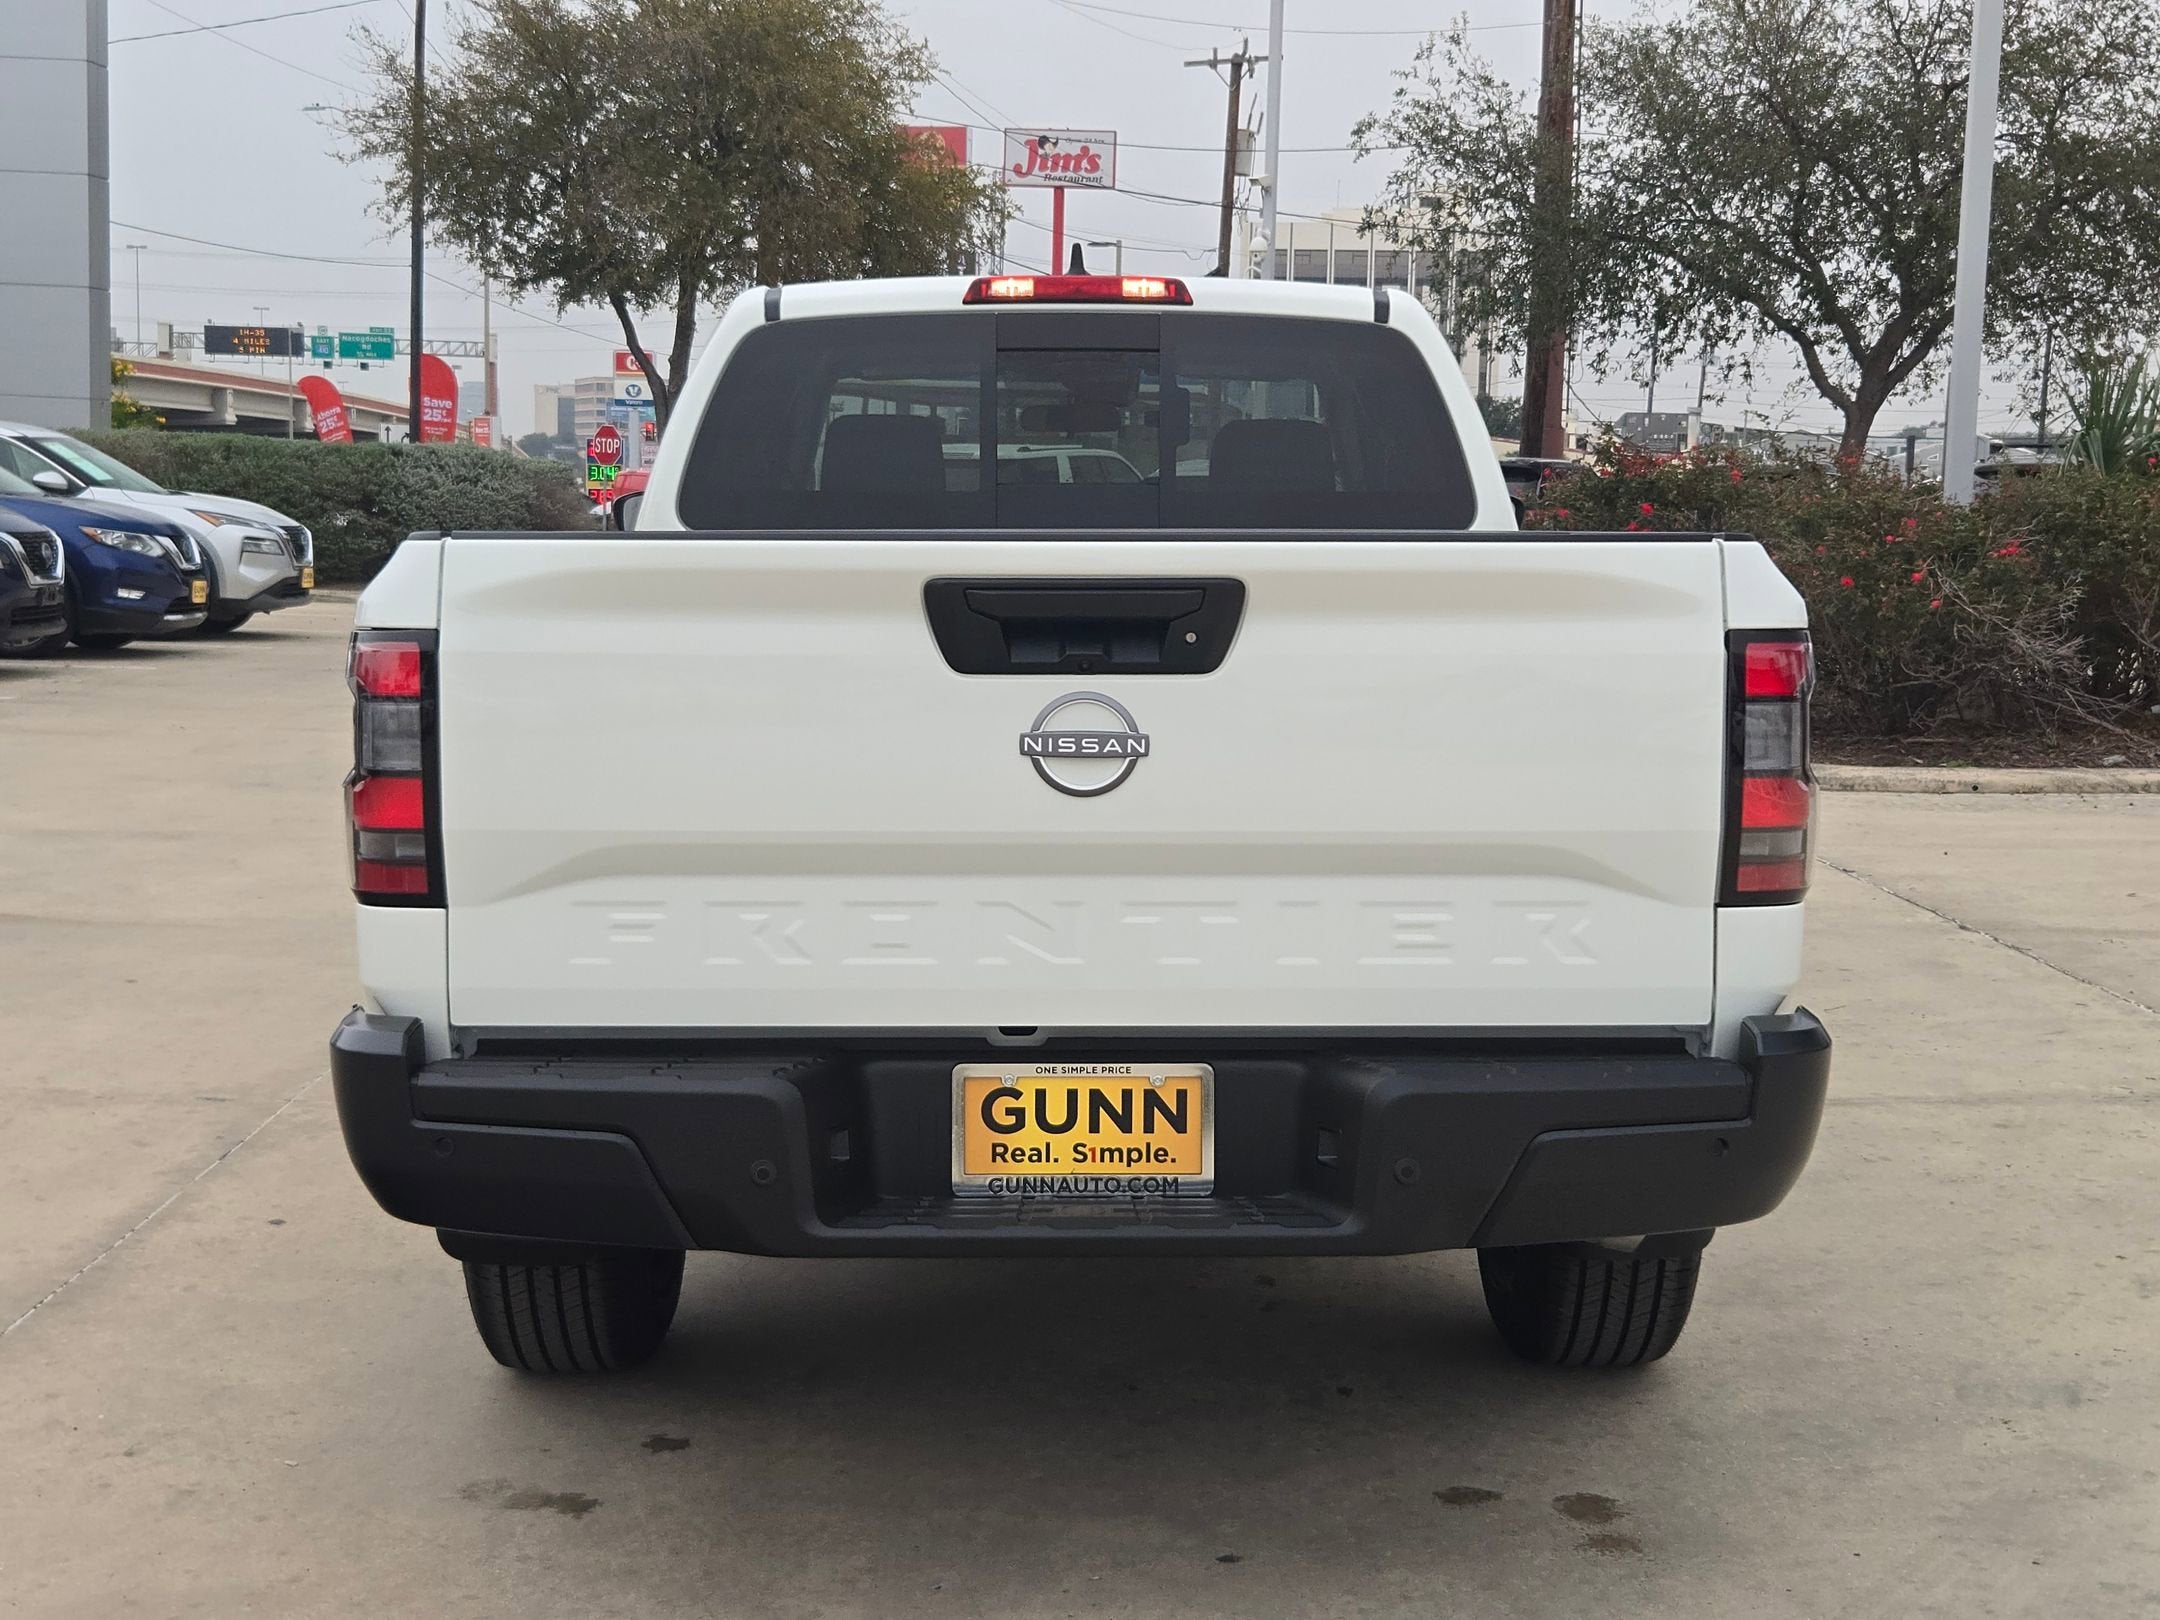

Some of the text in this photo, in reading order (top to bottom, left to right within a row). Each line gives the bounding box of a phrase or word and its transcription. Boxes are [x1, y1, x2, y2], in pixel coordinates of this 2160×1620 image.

[1013, 138, 1102, 178] Jim's
[1043, 173, 1103, 183] Restaurant
[342, 335, 391, 344] Nacogdoches
[423, 397, 453, 409] Save
[595, 438, 620, 454] STOP
[1024, 737, 1146, 754] NISSAN
[1035, 1066, 1132, 1075] ONE SIMPLE PRICE
[981, 1086, 1188, 1135] GUNN
[991, 1142, 1060, 1164] Real.
[987, 1176, 1179, 1195] GUNNAUTO.COM
